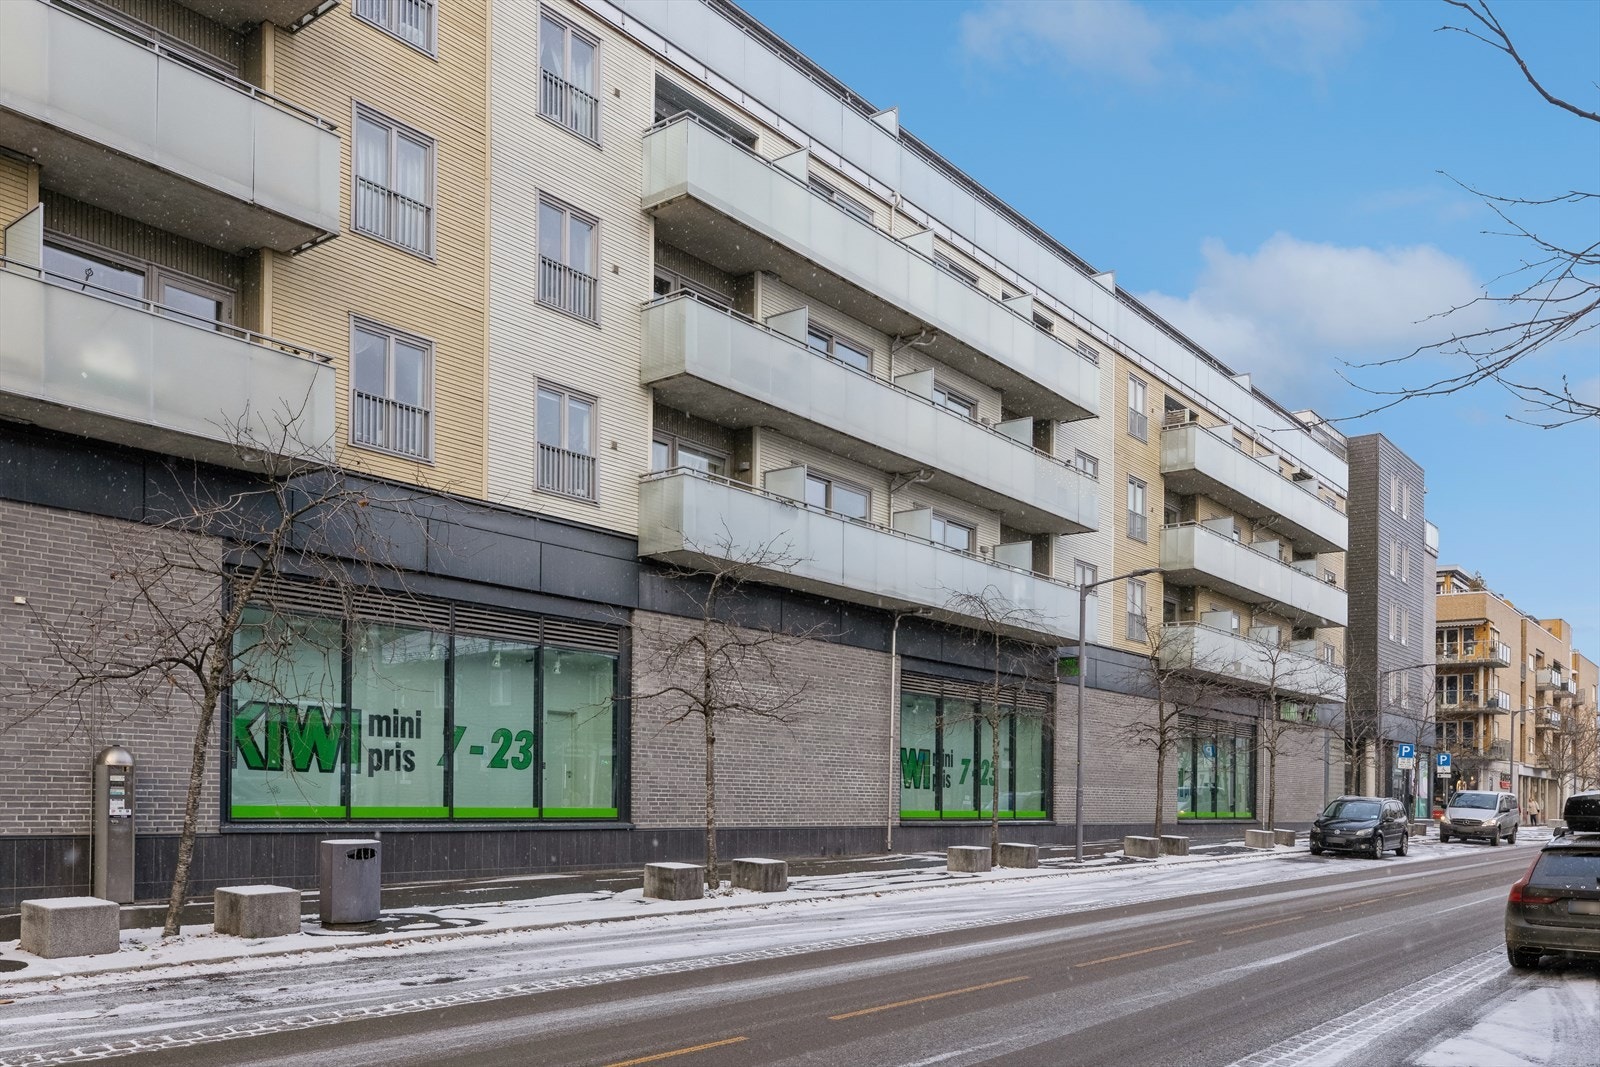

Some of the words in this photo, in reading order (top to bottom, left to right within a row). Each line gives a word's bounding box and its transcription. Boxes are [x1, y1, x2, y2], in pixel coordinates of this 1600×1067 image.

[231, 699, 362, 774] KIWI
[368, 708, 422, 739] mini
[368, 742, 416, 777] pris
[1402, 746, 1410, 756] P
